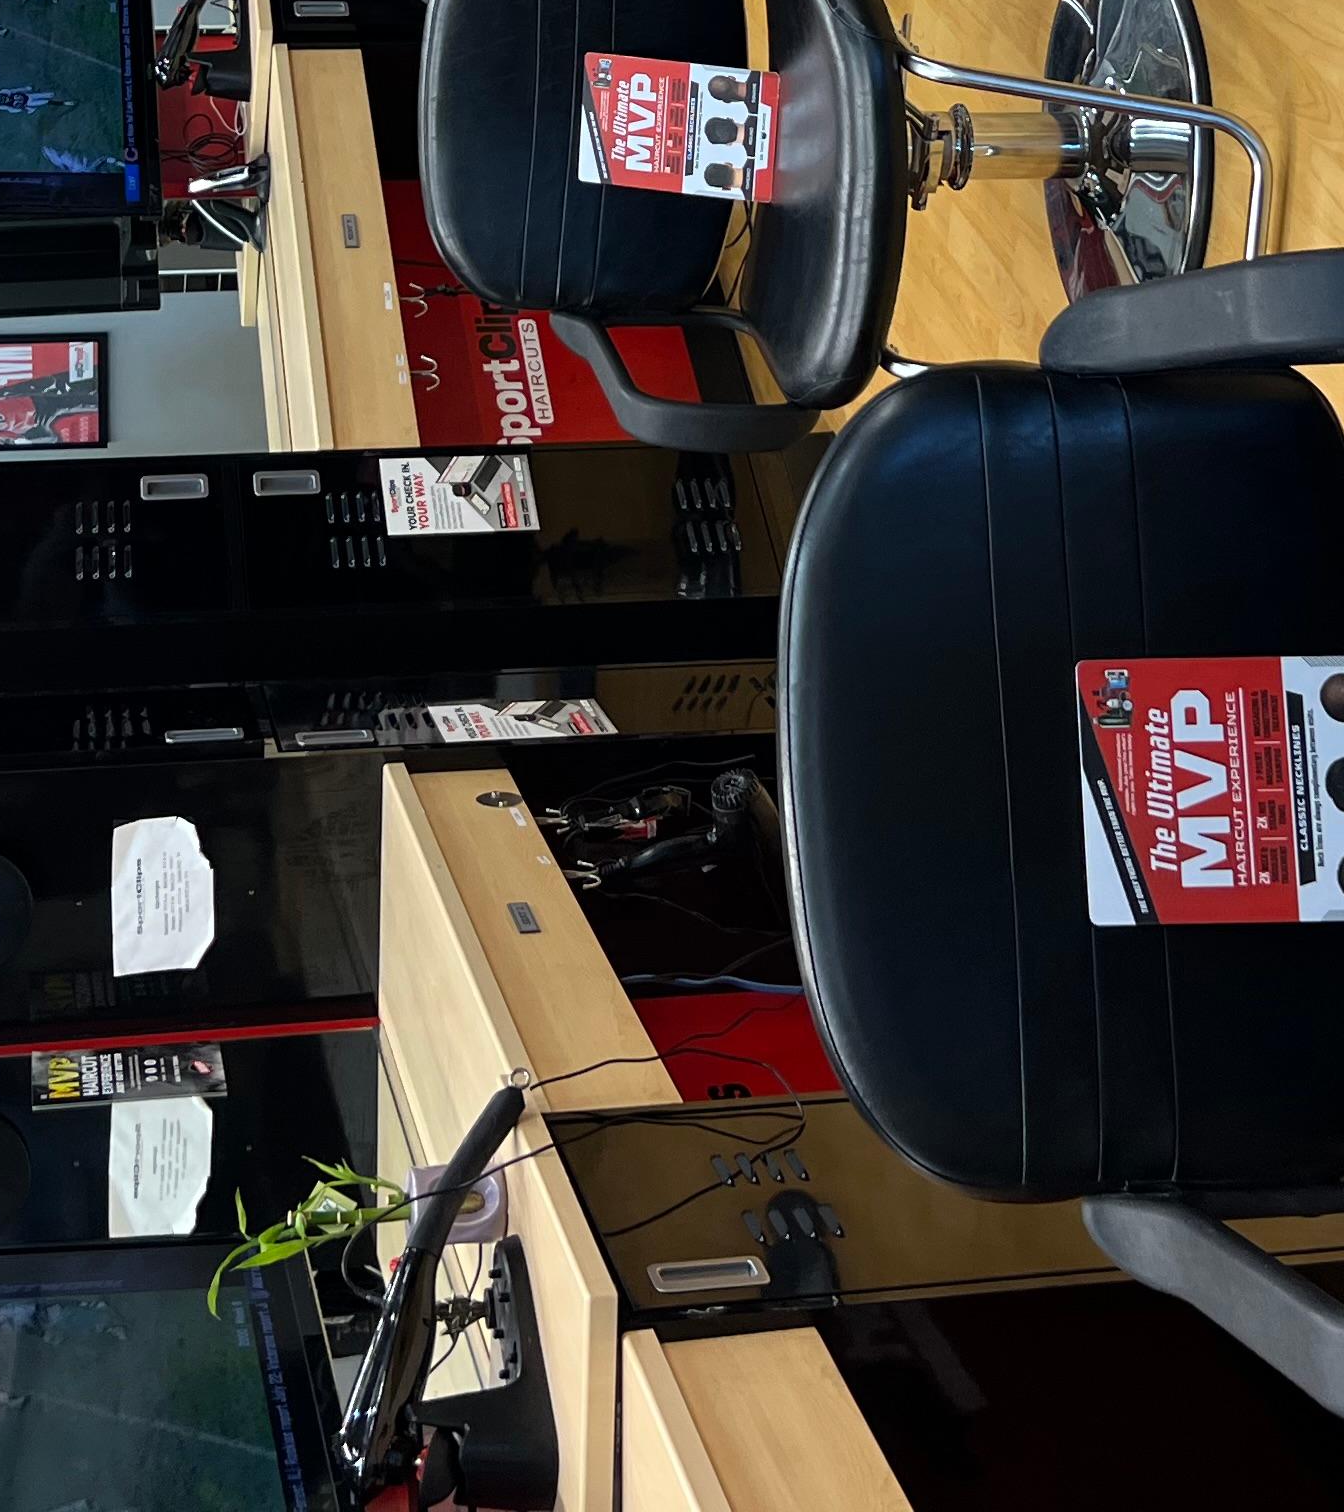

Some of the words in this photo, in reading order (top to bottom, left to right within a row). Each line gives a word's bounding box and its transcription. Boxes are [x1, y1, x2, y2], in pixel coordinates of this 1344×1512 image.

[611, 80, 630, 136] Ultimate
[625, 72, 657, 173] MVP
[655, 76, 665, 132] EXPERIENCE
[610, 140, 626, 161] The
[653, 135, 662, 173] HAIRCUT
[474, 299, 542, 445] portClip
[520, 322, 552, 420] HAIRCUTS
[402, 475, 414, 504] CHECK
[406, 506, 418, 531] YOUR
[416, 500, 430, 530] YOUR
[1144, 708, 1175, 820] Ultimate
[1225, 691, 1243, 802] EXPERIENCE
[1291, 724, 1306, 796] NECKLINES
[1170, 689, 1235, 888] MVP
[1233, 807, 1248, 886] HAIRCUT
[1256, 816, 1268, 829] 2X
[1296, 798, 1310, 851] CLASSIC
[1149, 828, 1178, 872] The
[1258, 871, 1271, 885] 2X
[47, 1057, 81, 1098] MVP
[81, 1055, 100, 1096] HAIRCUT
[100, 1053, 114, 1094] EXPERIENCE
